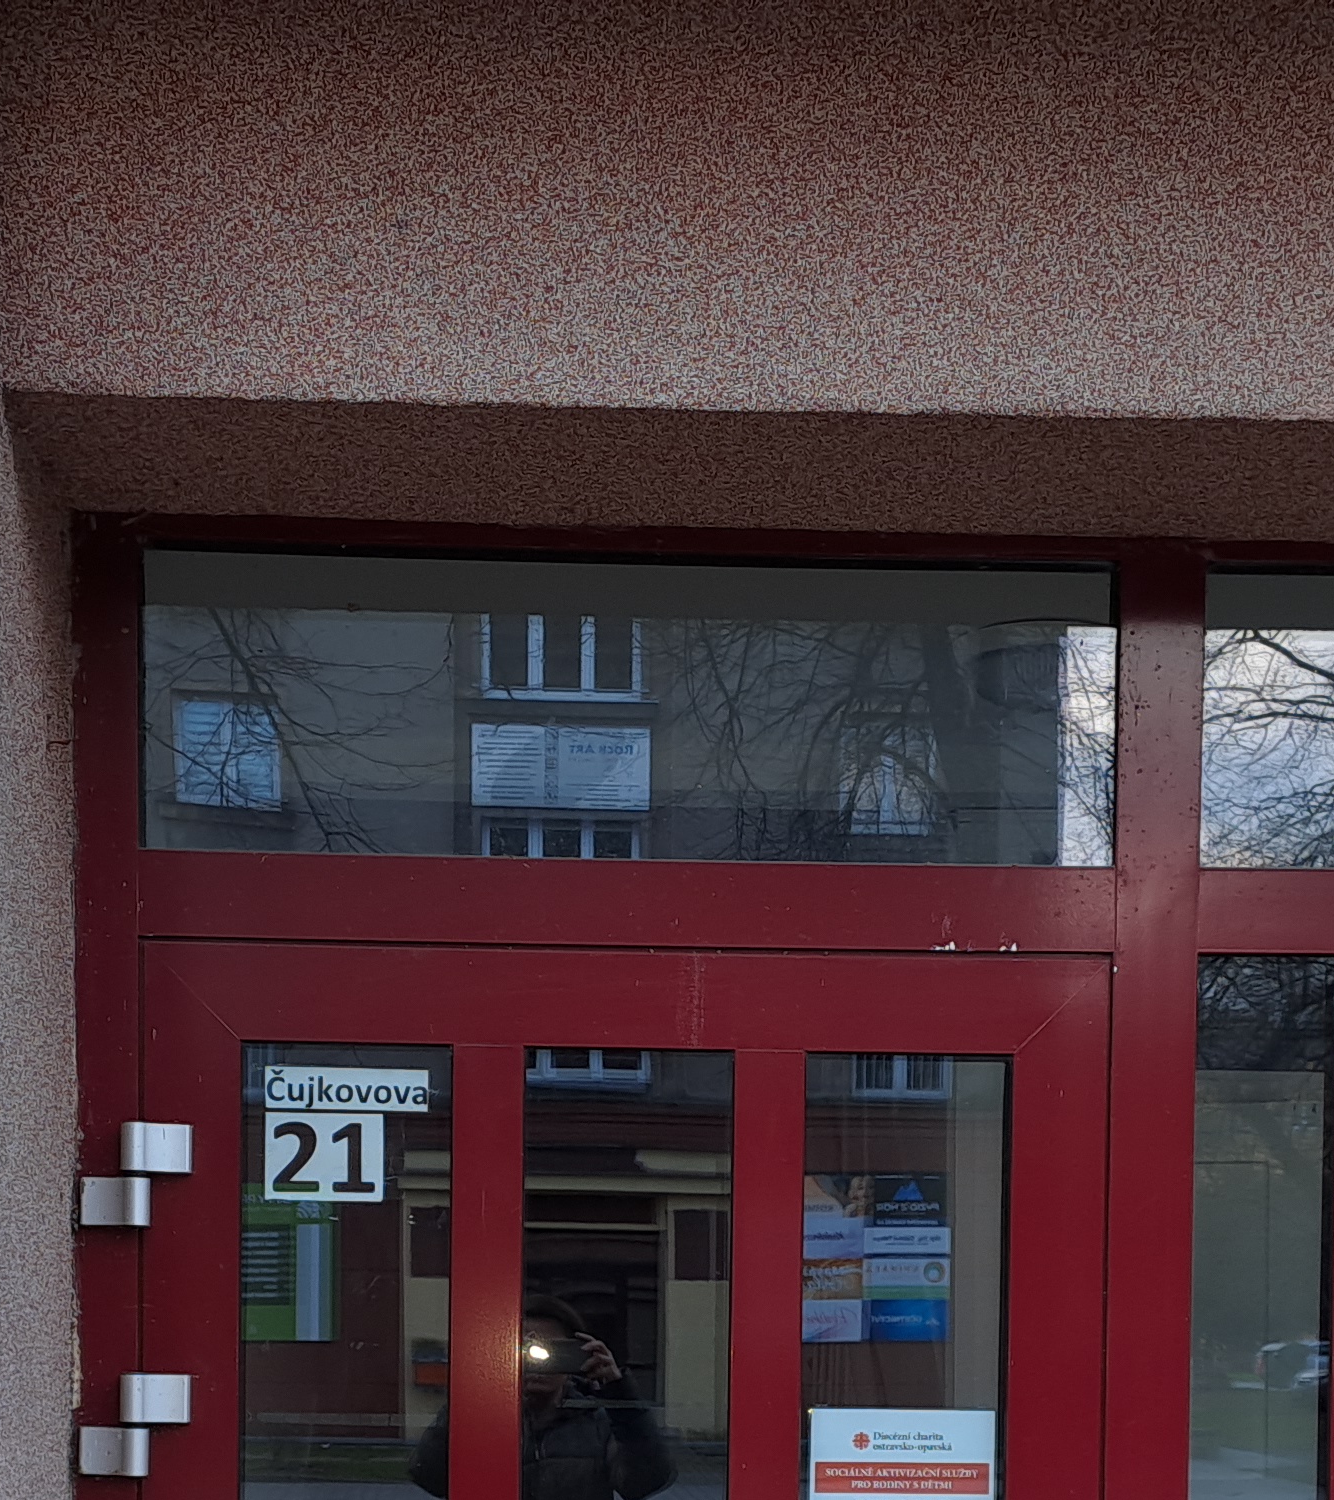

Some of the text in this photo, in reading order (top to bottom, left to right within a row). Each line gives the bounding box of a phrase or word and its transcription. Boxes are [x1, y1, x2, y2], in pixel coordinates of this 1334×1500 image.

[267, 1069, 427, 1108] Čujkovova
[272, 1121, 375, 1192] 21
[913, 1432, 944, 1440] charita
[851, 1481, 871, 1489] PRO
